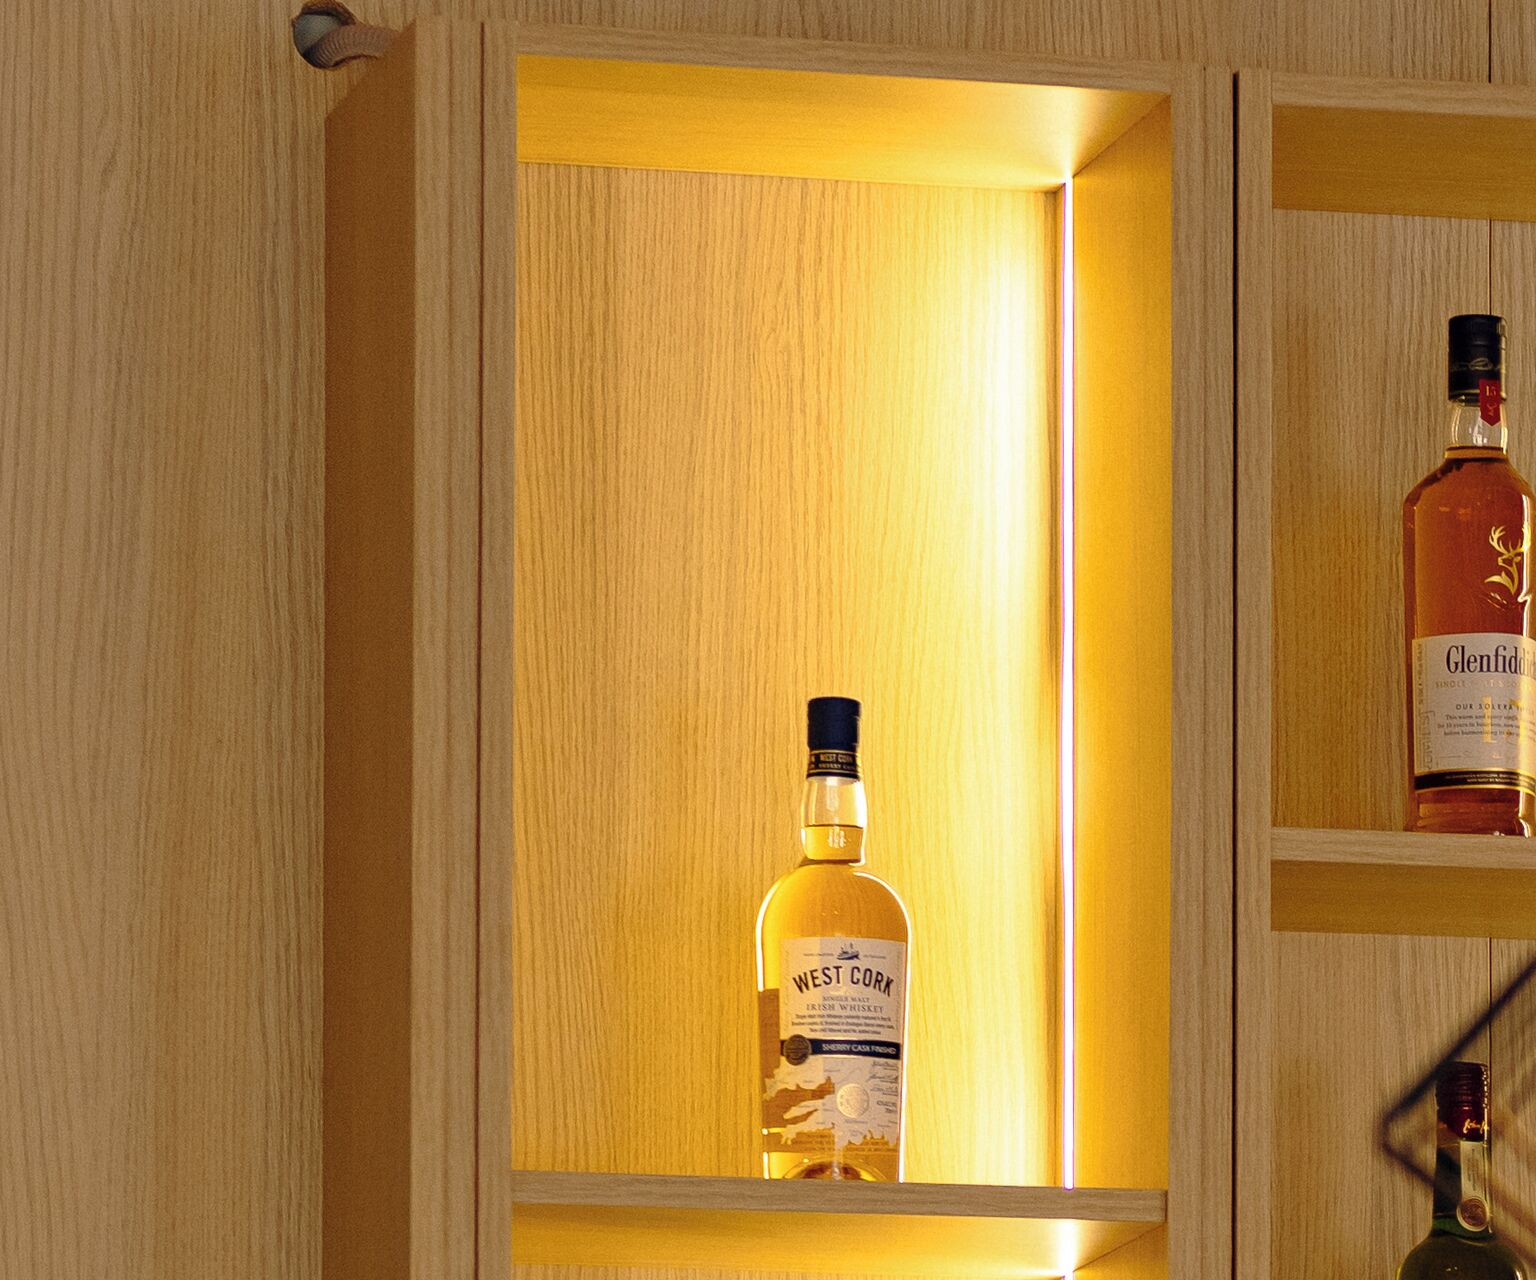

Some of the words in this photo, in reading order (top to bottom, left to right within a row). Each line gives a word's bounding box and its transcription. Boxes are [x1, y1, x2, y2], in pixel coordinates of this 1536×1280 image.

[792, 964, 844, 995] WEST
[850, 965, 895, 998] CORK
[806, 1003, 837, 1013] IRISH
[839, 1003, 885, 1014] WHISKEY
